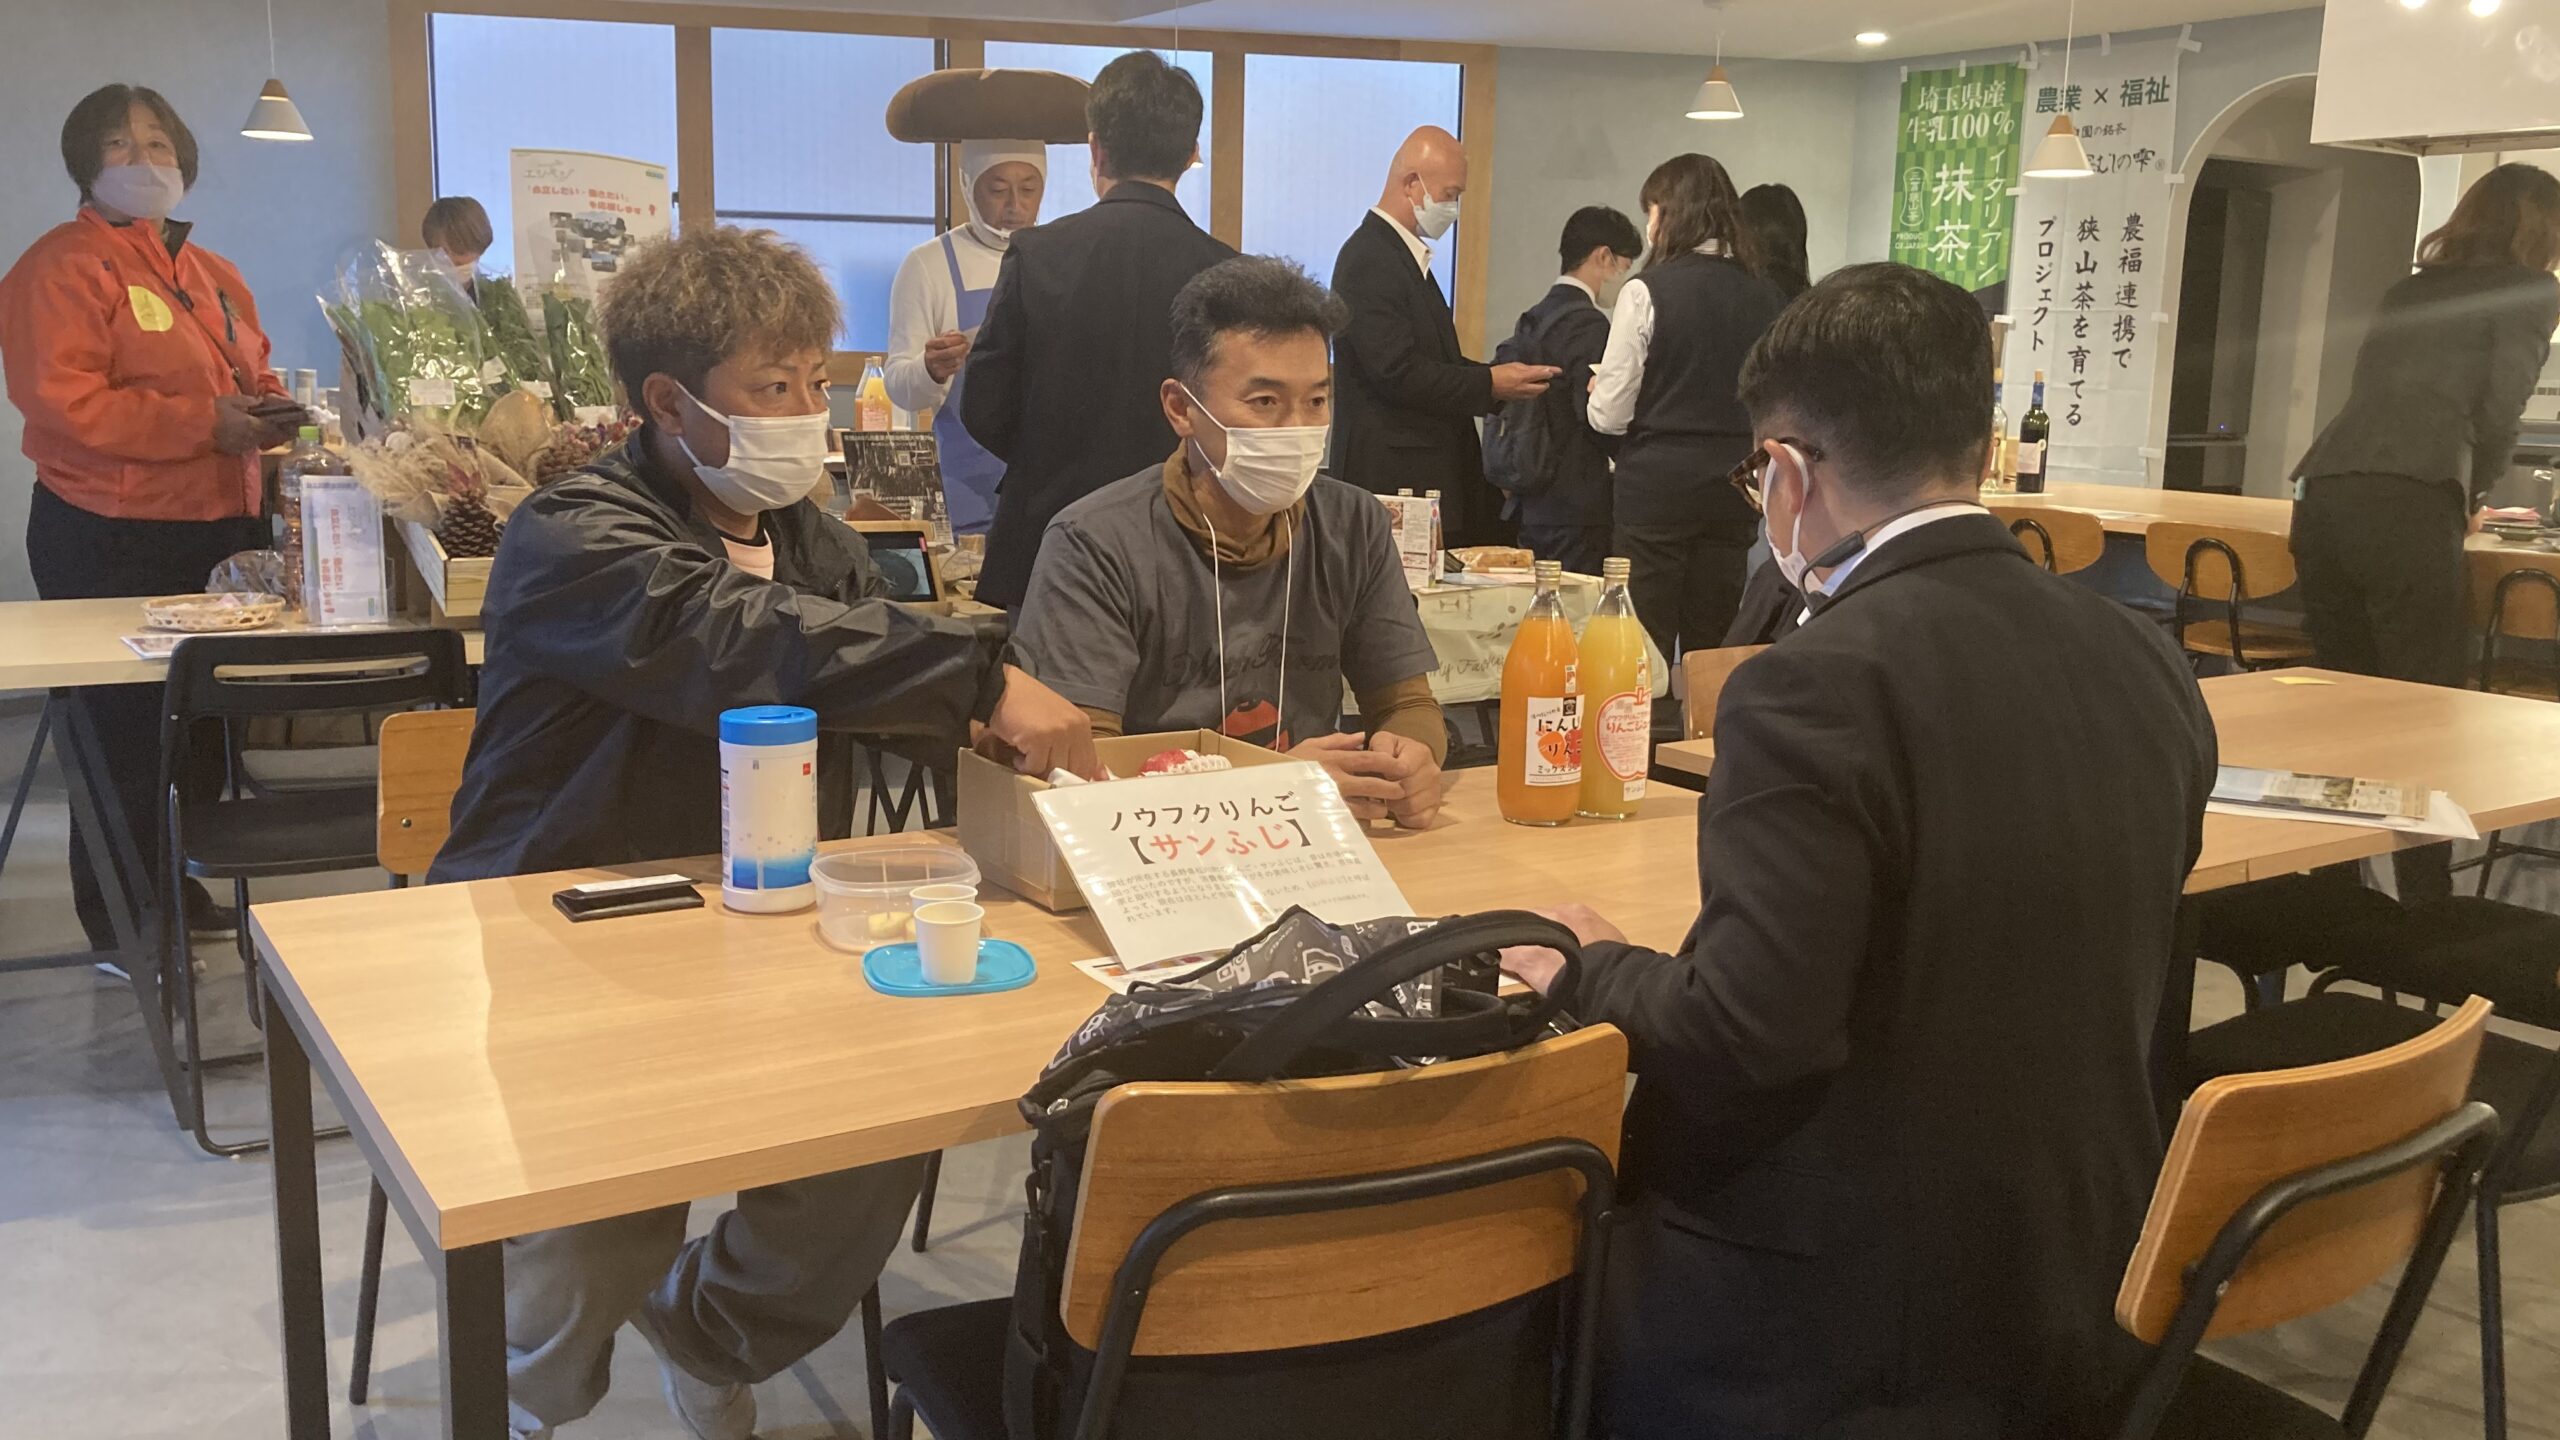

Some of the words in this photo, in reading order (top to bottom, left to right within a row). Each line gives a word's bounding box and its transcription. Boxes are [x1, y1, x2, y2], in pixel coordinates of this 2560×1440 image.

[1906, 110, 2015, 144] 牛乳100%
[1917, 80, 2006, 114] 埼玉県産
[2036, 84, 2082, 113] 農業
[2120, 75, 2170, 107] 福祉
[1927, 162, 1976, 263] 抹茶
[1978, 149, 2006, 282] イタリアン
[2032, 215, 2058, 352] プロジェクト
[2112, 212, 2145, 369] 農福連携で
[2066, 215, 2100, 427] 狭山茶を育てる
[1110, 791, 1300, 831] ノウフクりんご
[1128, 818, 1311, 865] 【サンふじ】
